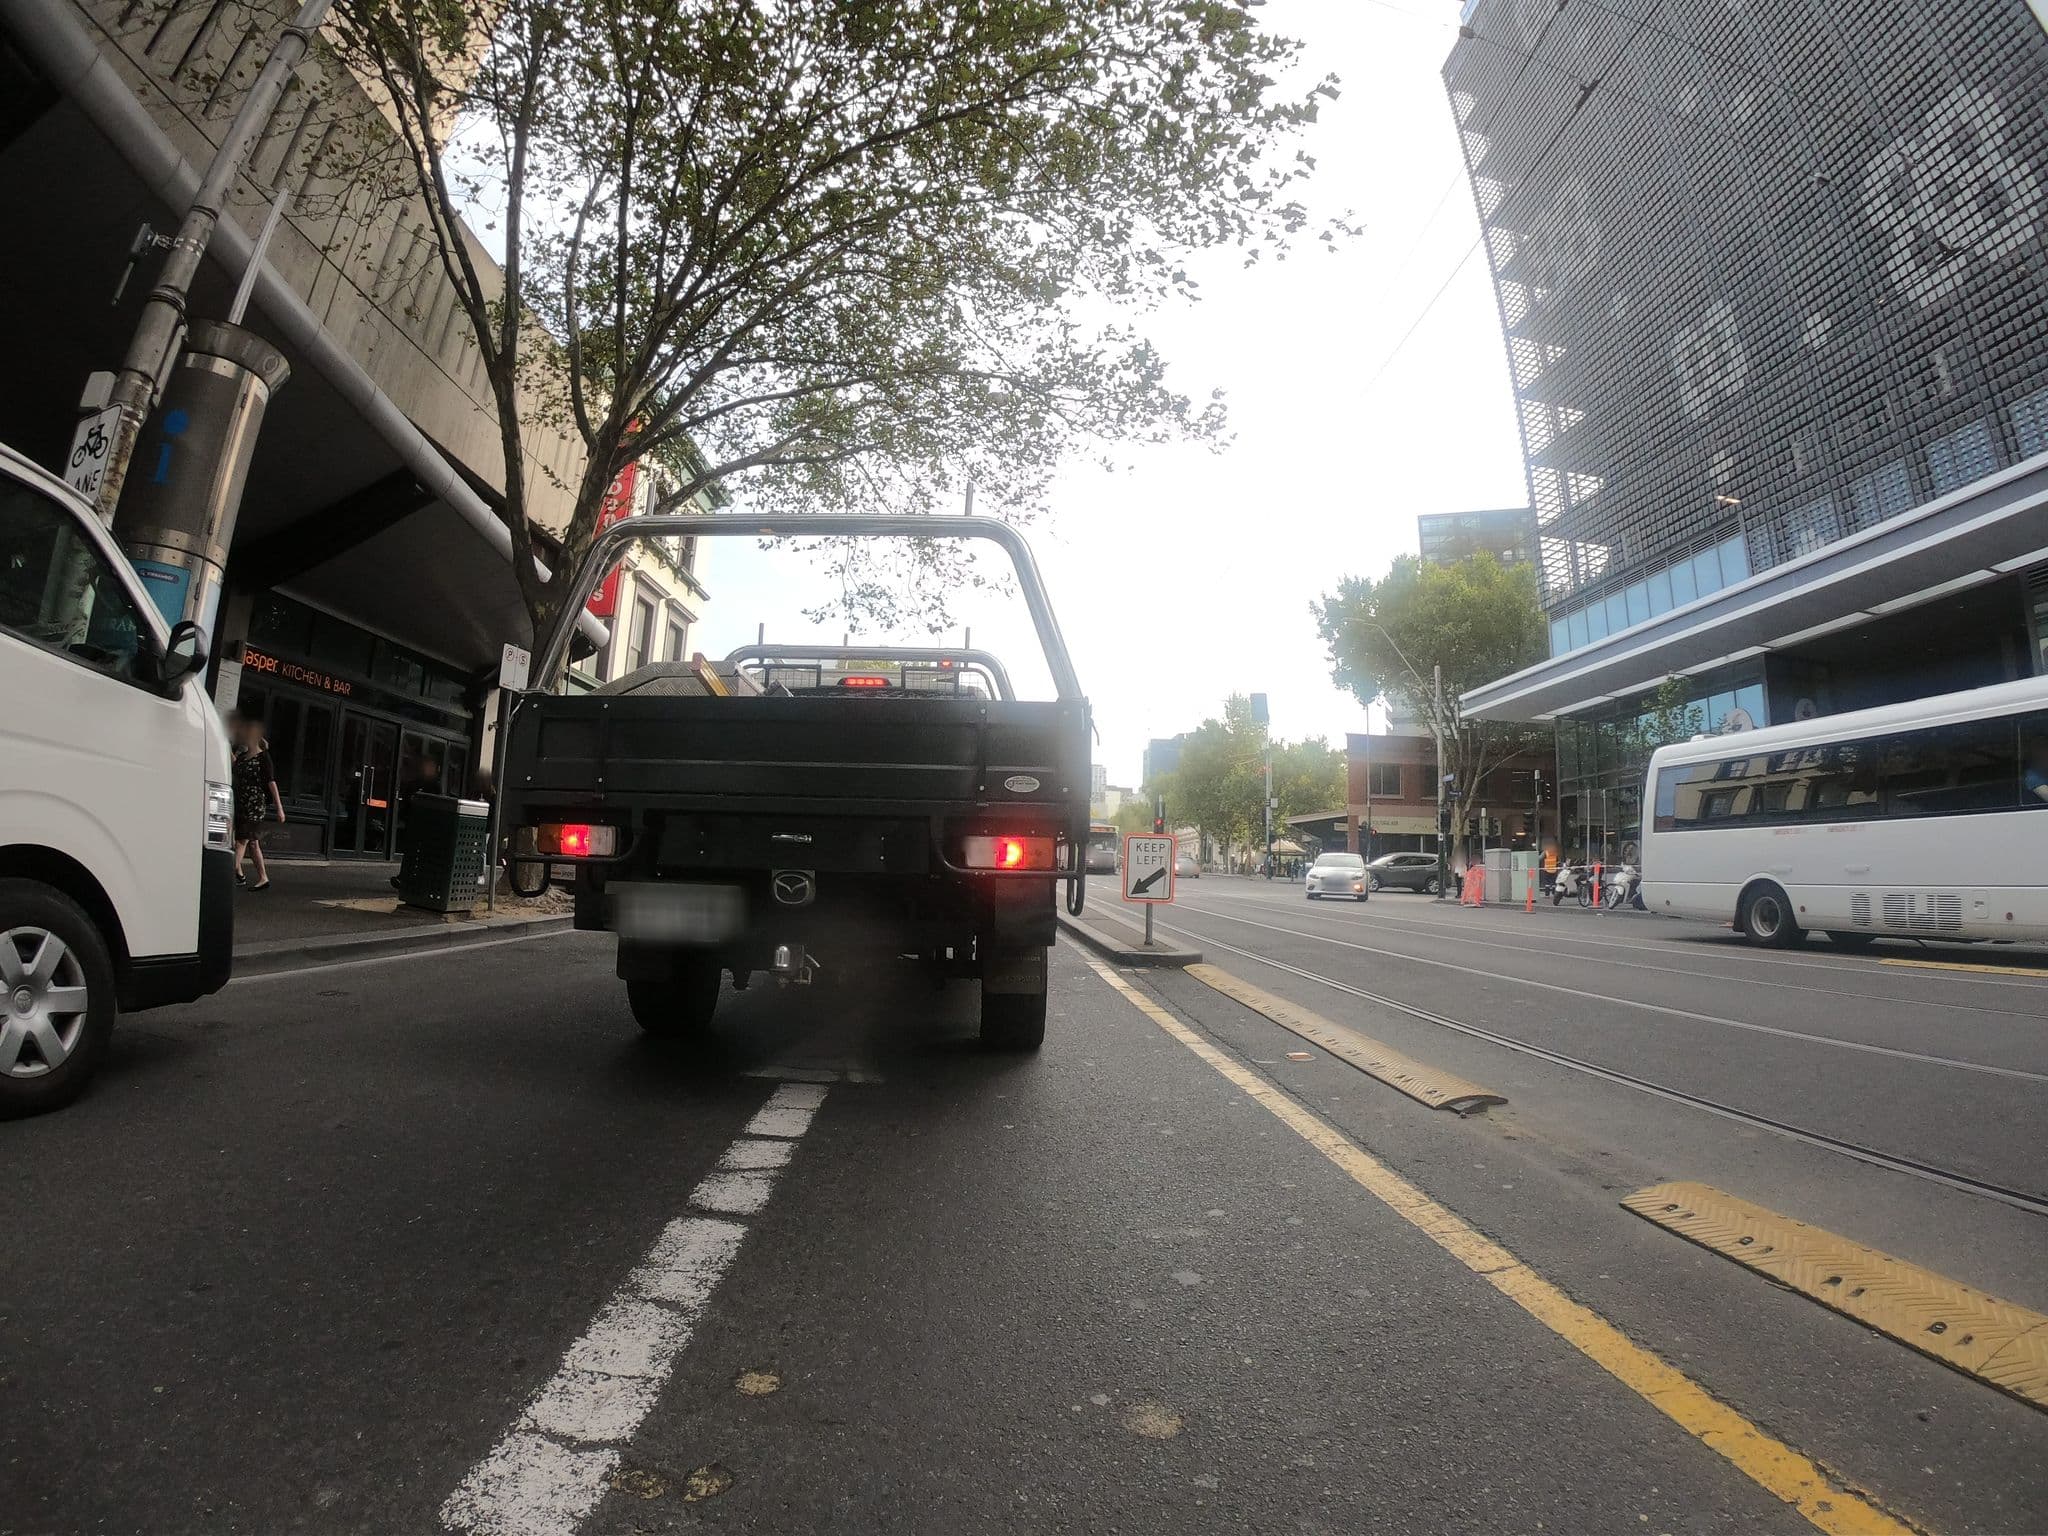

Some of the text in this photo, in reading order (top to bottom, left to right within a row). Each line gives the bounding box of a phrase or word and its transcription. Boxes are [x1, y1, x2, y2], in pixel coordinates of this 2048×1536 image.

[67, 470, 101, 494] ANE
[281, 663, 322, 686] KITCHEN
[323, 676, 331, 689] &
[333, 679, 352, 695] BAR
[1136, 842, 1166, 853] KEEP
[1136, 855, 1165, 865] LEFT
